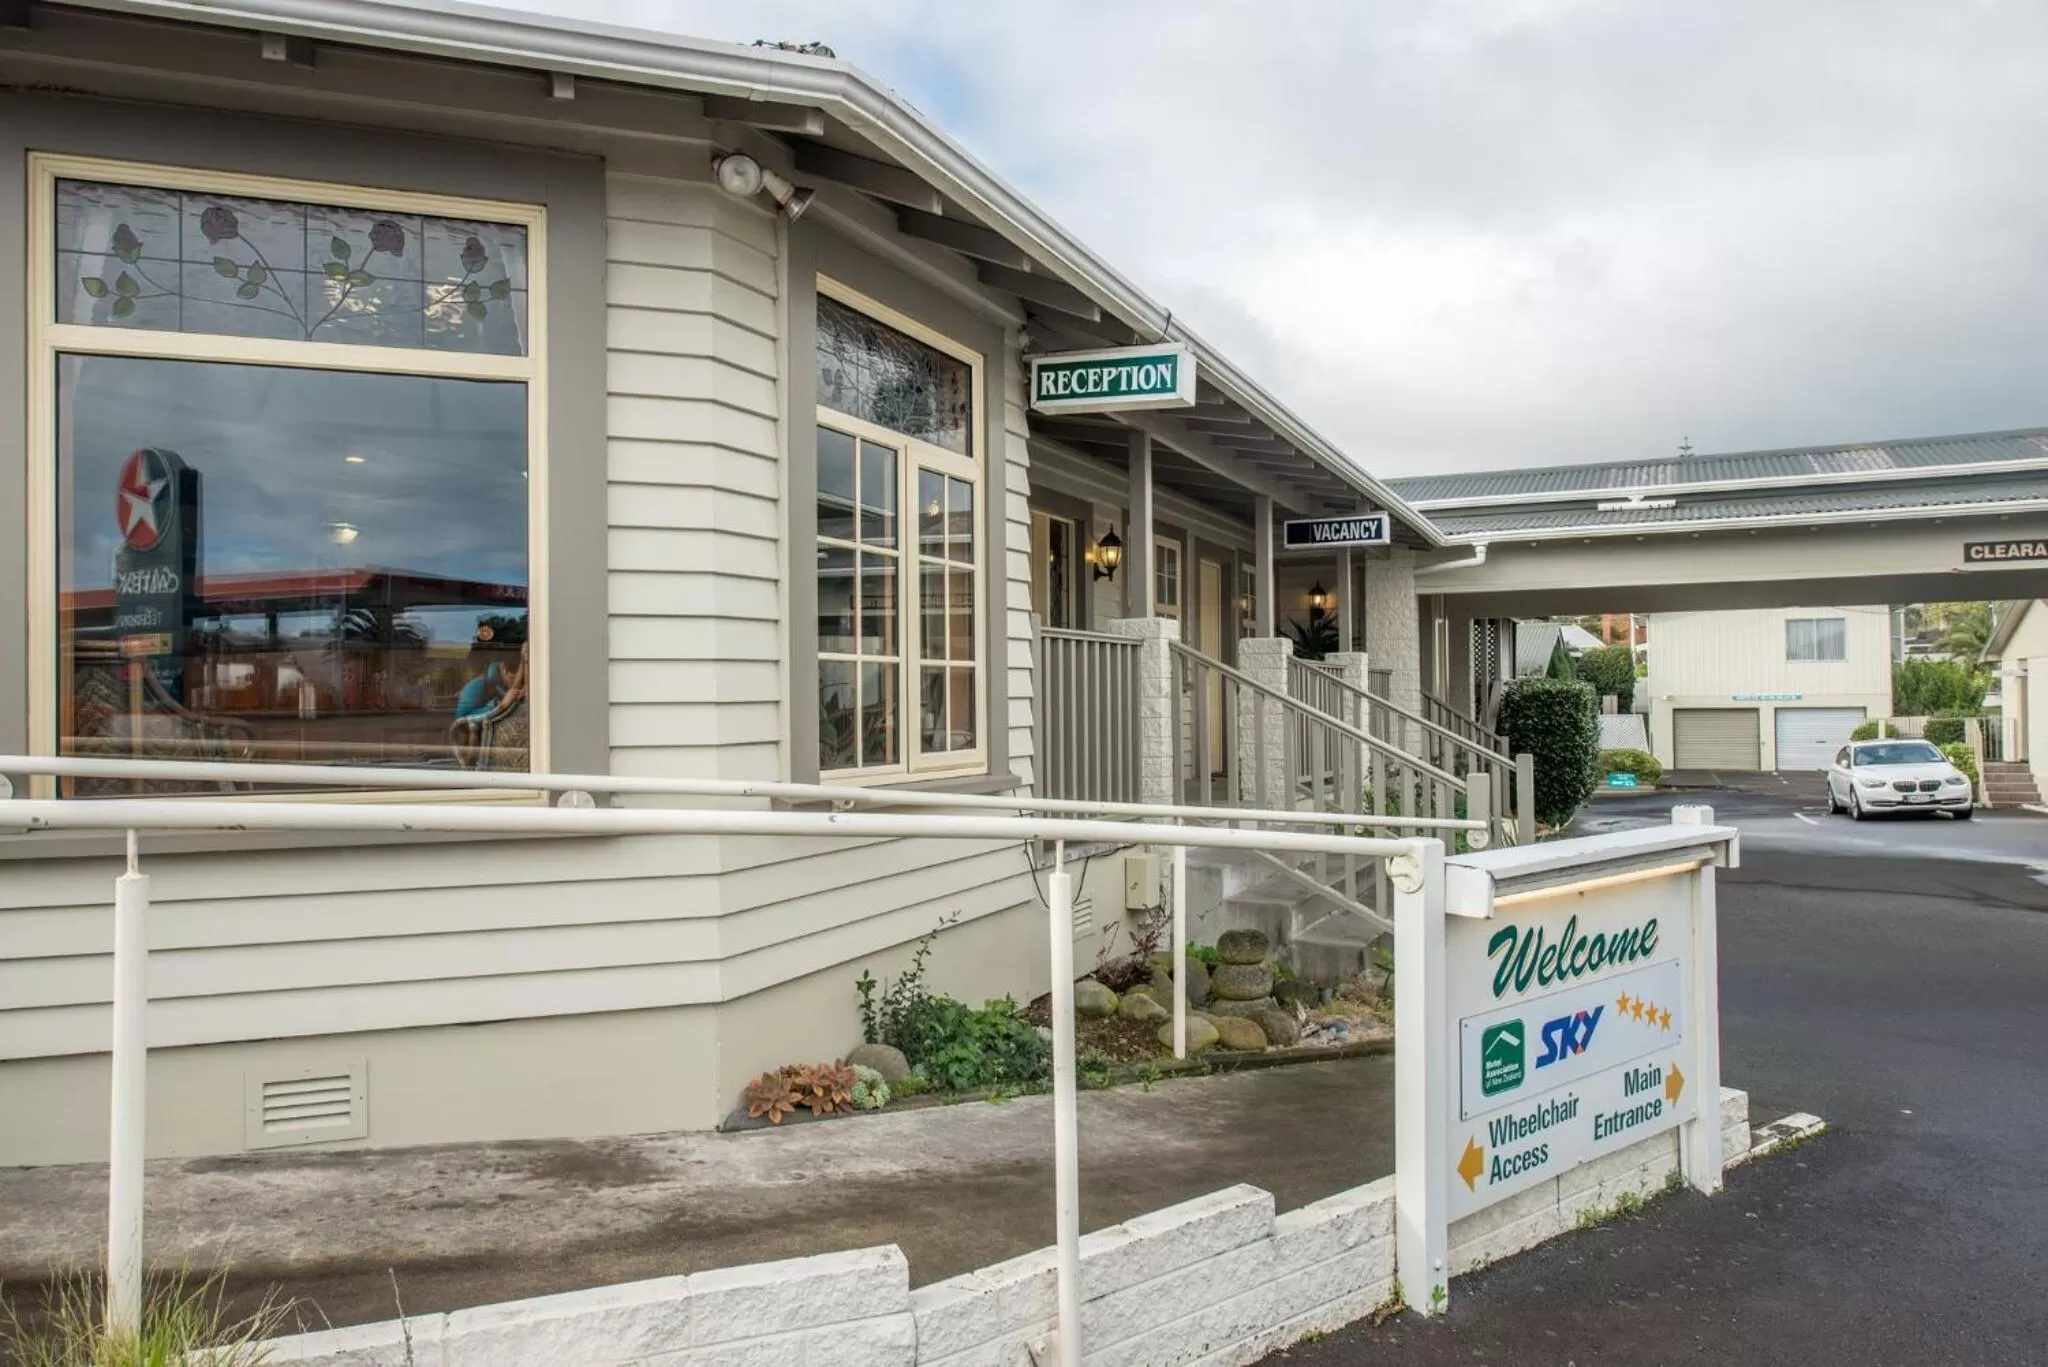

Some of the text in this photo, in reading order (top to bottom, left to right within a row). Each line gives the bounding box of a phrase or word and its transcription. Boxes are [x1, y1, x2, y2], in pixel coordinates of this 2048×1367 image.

[1040, 363, 1173, 396] RECEPTION
[1313, 520, 1378, 541] VACANCY
[1970, 542, 2048, 559] CLEARA
[1487, 914, 1659, 999] Welcome
[1535, 1004, 1605, 1069] SKY
[1624, 1063, 1662, 1097] Main
[1488, 1092, 1579, 1148] Wheelchair
[1594, 1098, 1662, 1141] Entrance
[1489, 1143, 1549, 1185] Access
